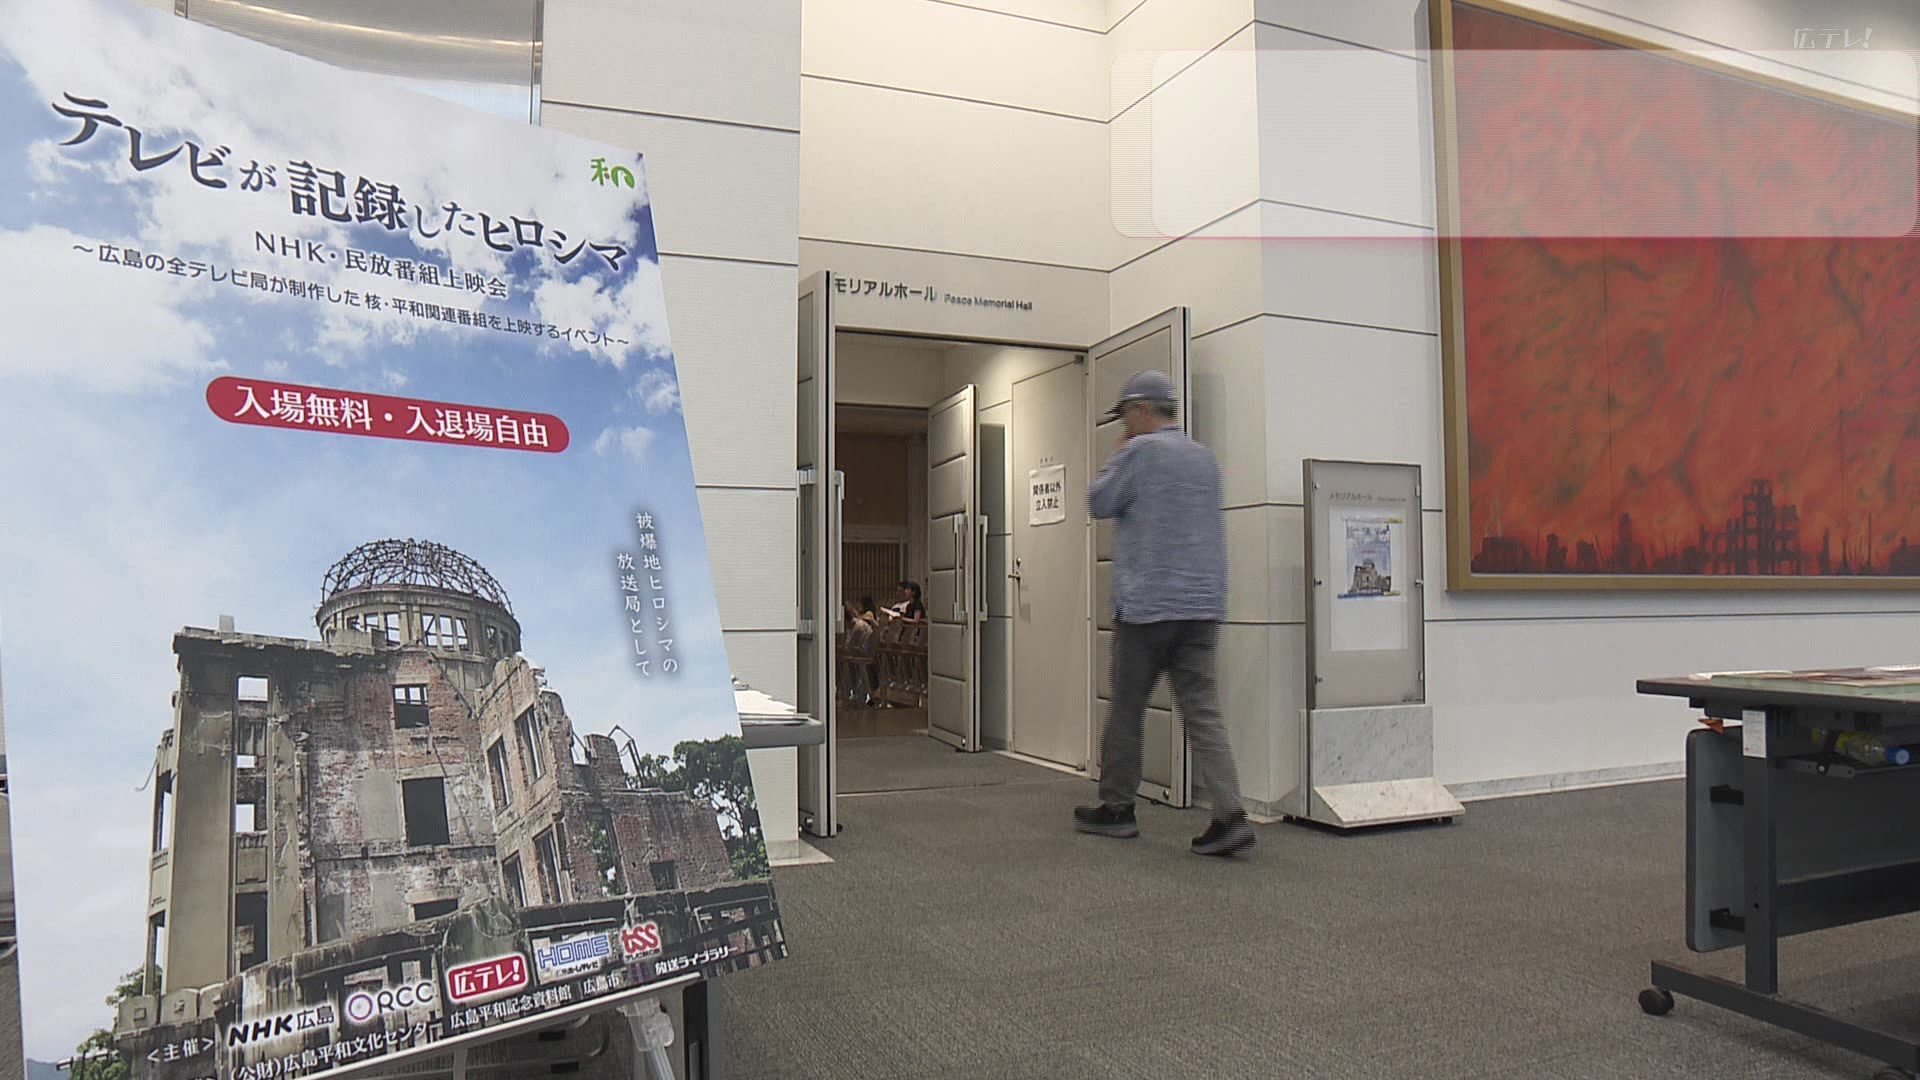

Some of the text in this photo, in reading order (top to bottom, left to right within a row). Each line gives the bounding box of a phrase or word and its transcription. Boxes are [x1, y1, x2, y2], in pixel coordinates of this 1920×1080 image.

[51, 91, 628, 272] テレビが記録したヒロシマ
[255, 231, 507, 298] NHK・民放番組上映会
[944, 293, 1033, 311] Peace Memorial Hall
[234, 385, 549, 447] 入場無料・入退場自由
[1036, 497, 1059, 511] 立入禁止
[617, 553, 650, 676] 放送局として
[636, 512, 678, 673] 被爆地ヒロシマの
[538, 935, 610, 969] HOME
[655, 945, 738, 976] 放送ライブラリー
[454, 959, 520, 996] 広テレ!
